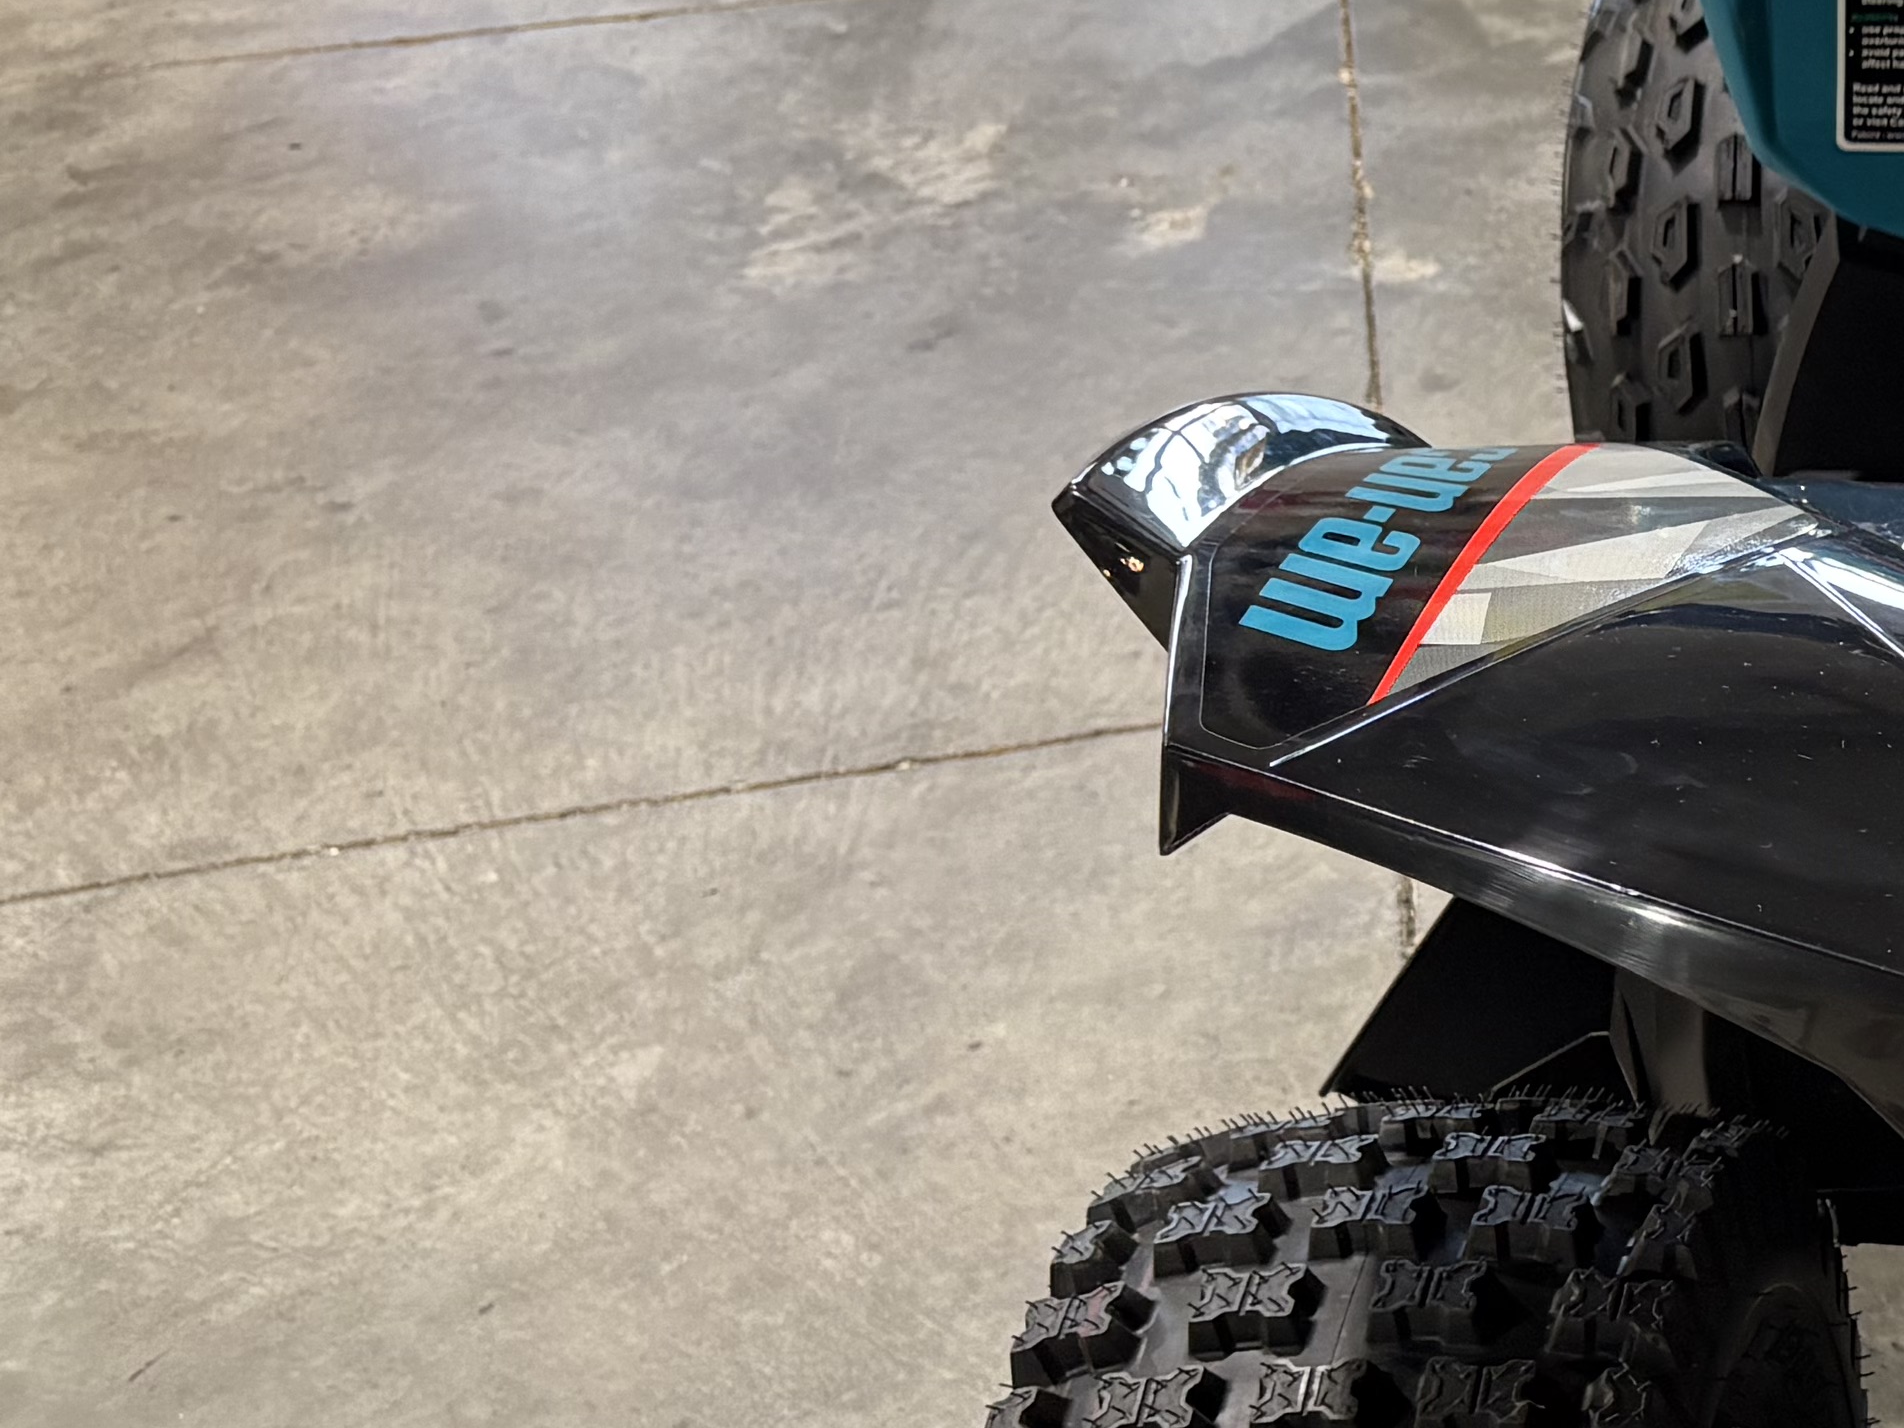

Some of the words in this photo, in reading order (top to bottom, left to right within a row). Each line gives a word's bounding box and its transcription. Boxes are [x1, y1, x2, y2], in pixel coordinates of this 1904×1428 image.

[1861, 25, 1881, 35] use
[1861, 47, 1890, 58] avoid
[1852, 82, 1880, 93] Read
[1881, 83, 1902, 94] and
[1852, 106, 1869, 117] the
[1871, 106, 1903, 119] safety
[1866, 117, 1888, 127] visit
